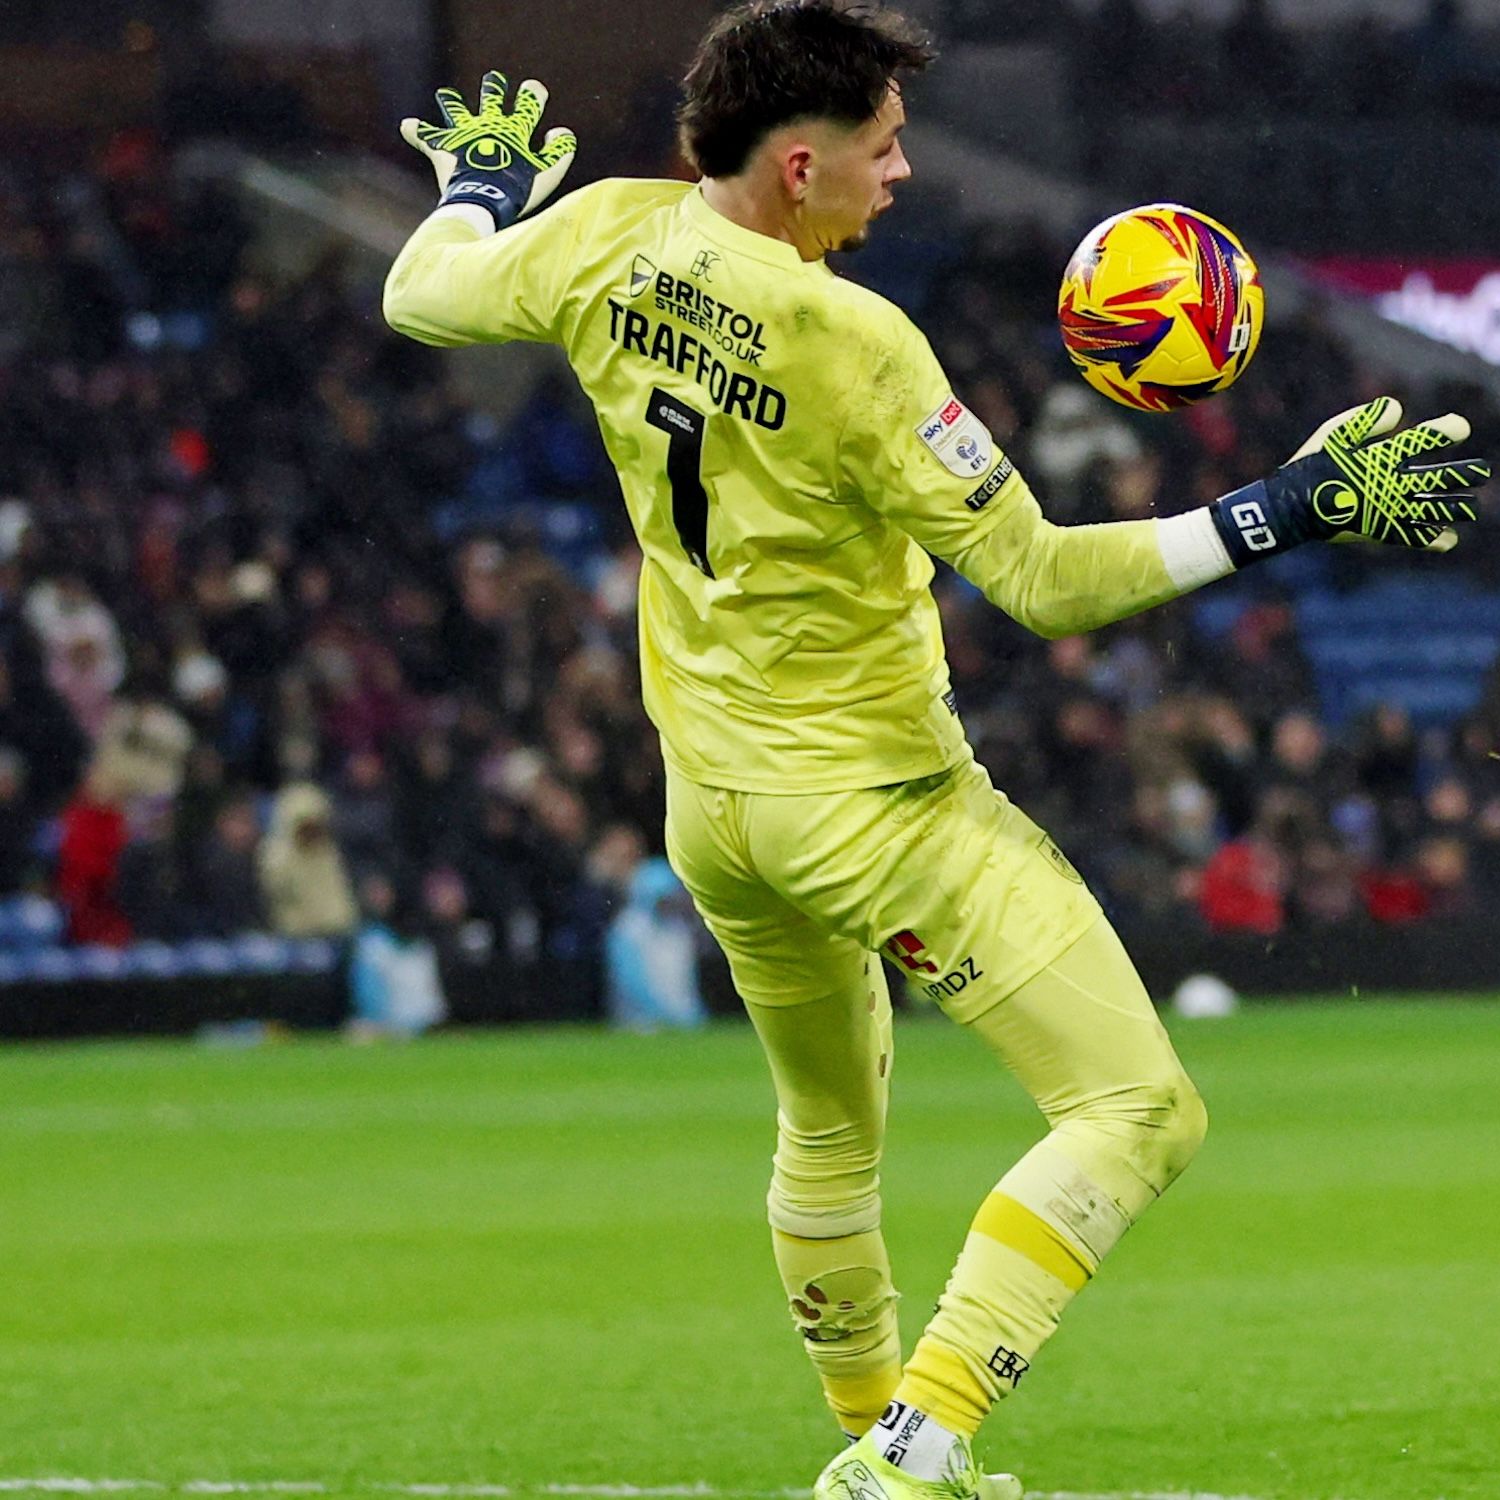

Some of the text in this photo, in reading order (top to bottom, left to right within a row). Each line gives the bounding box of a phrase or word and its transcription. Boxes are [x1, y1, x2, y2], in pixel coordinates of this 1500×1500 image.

[655, 271, 767, 351] BRISTOL
[607, 297, 787, 432] TRAFFORD
[923, 420, 944, 441] sky
[941, 401, 962, 424] bet
[645, 386, 715, 580] 1
[970, 454, 987, 471] EFL
[1230, 501, 1277, 552] GD
